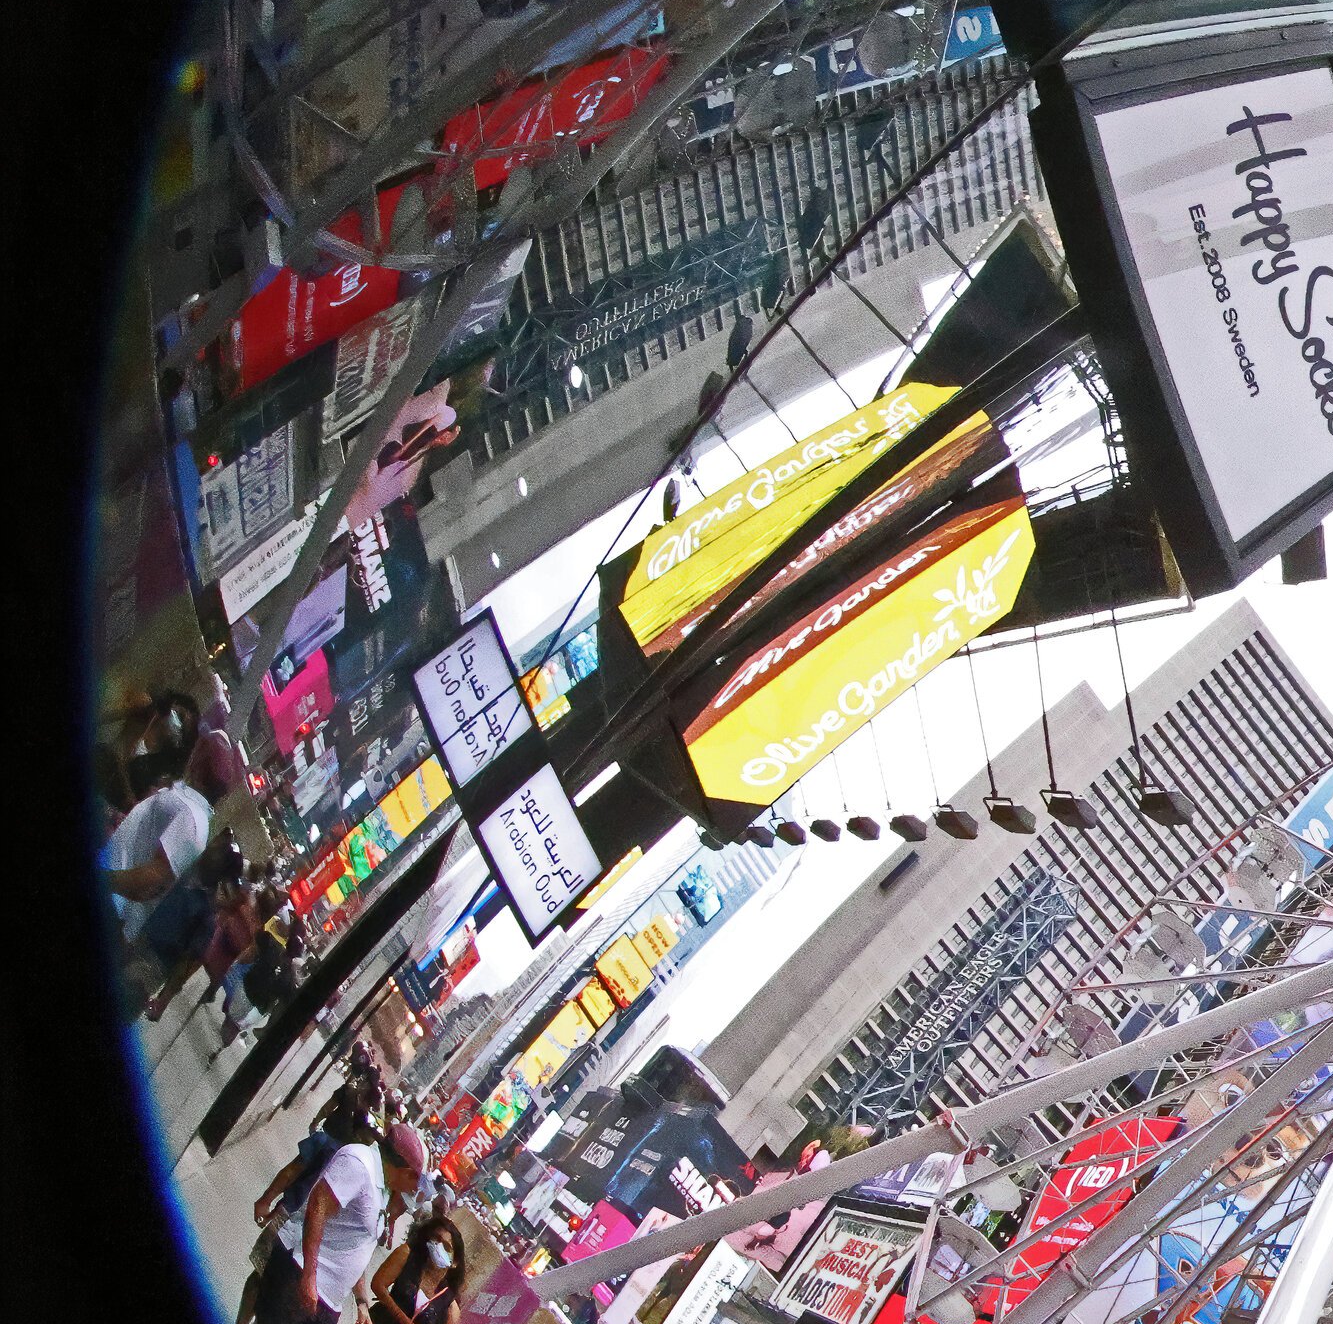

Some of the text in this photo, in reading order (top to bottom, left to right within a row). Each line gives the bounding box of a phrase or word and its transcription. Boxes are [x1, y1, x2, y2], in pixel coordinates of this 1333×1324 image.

[1226, 106, 1307, 285] Happy
[1223, 308, 1259, 398] Sweden
[815, 544, 942, 631] Garden
[740, 623, 961, 787] Olive Garden
[500, 809, 564, 914] Arabian Oud
[887, 932, 1006, 1068] AMERICAN EAGLE
[917, 959, 1003, 1053] OUTFITTERS
[819, 1251, 870, 1284] MUSICAL
[840, 1238, 879, 1261] BEST
